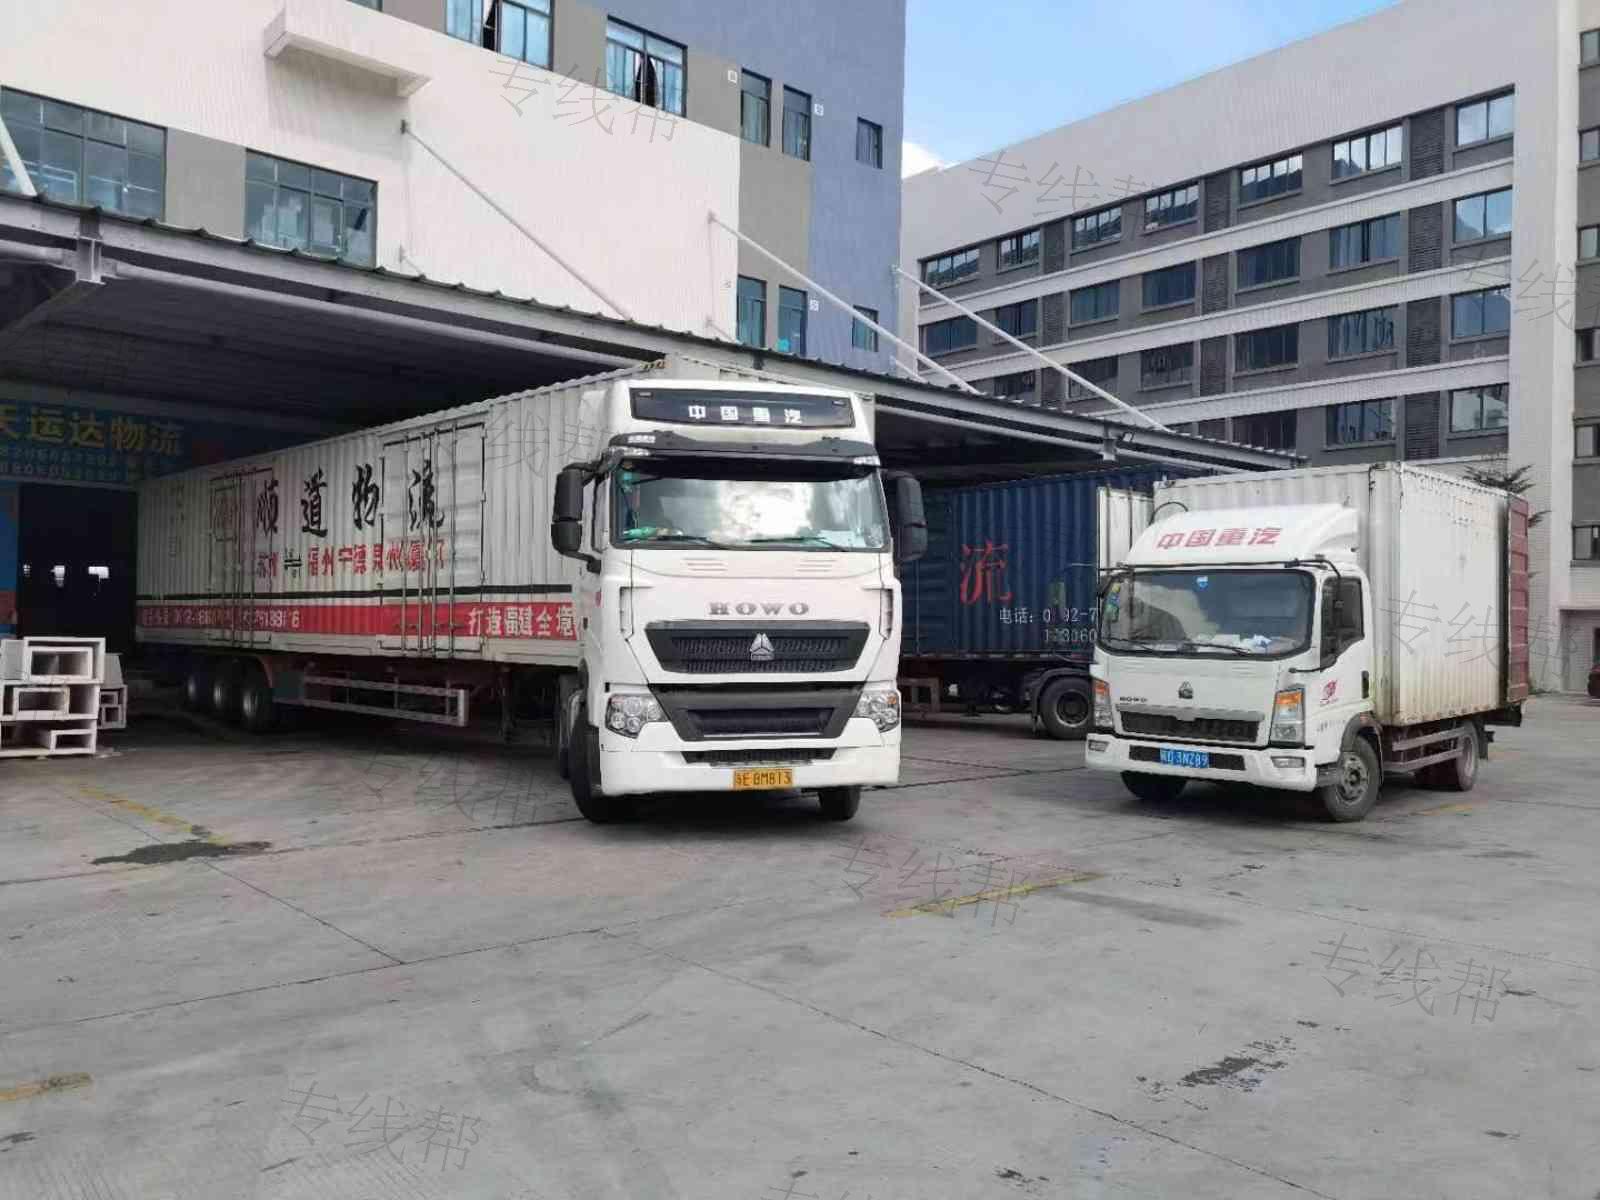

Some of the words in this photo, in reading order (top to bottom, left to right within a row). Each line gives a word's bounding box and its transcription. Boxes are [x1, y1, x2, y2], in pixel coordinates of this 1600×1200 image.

[688, 404, 803, 424] 中国重汽
[1156, 527, 1283, 550] 中国重汽
[708, 602, 809, 616] HOWO
